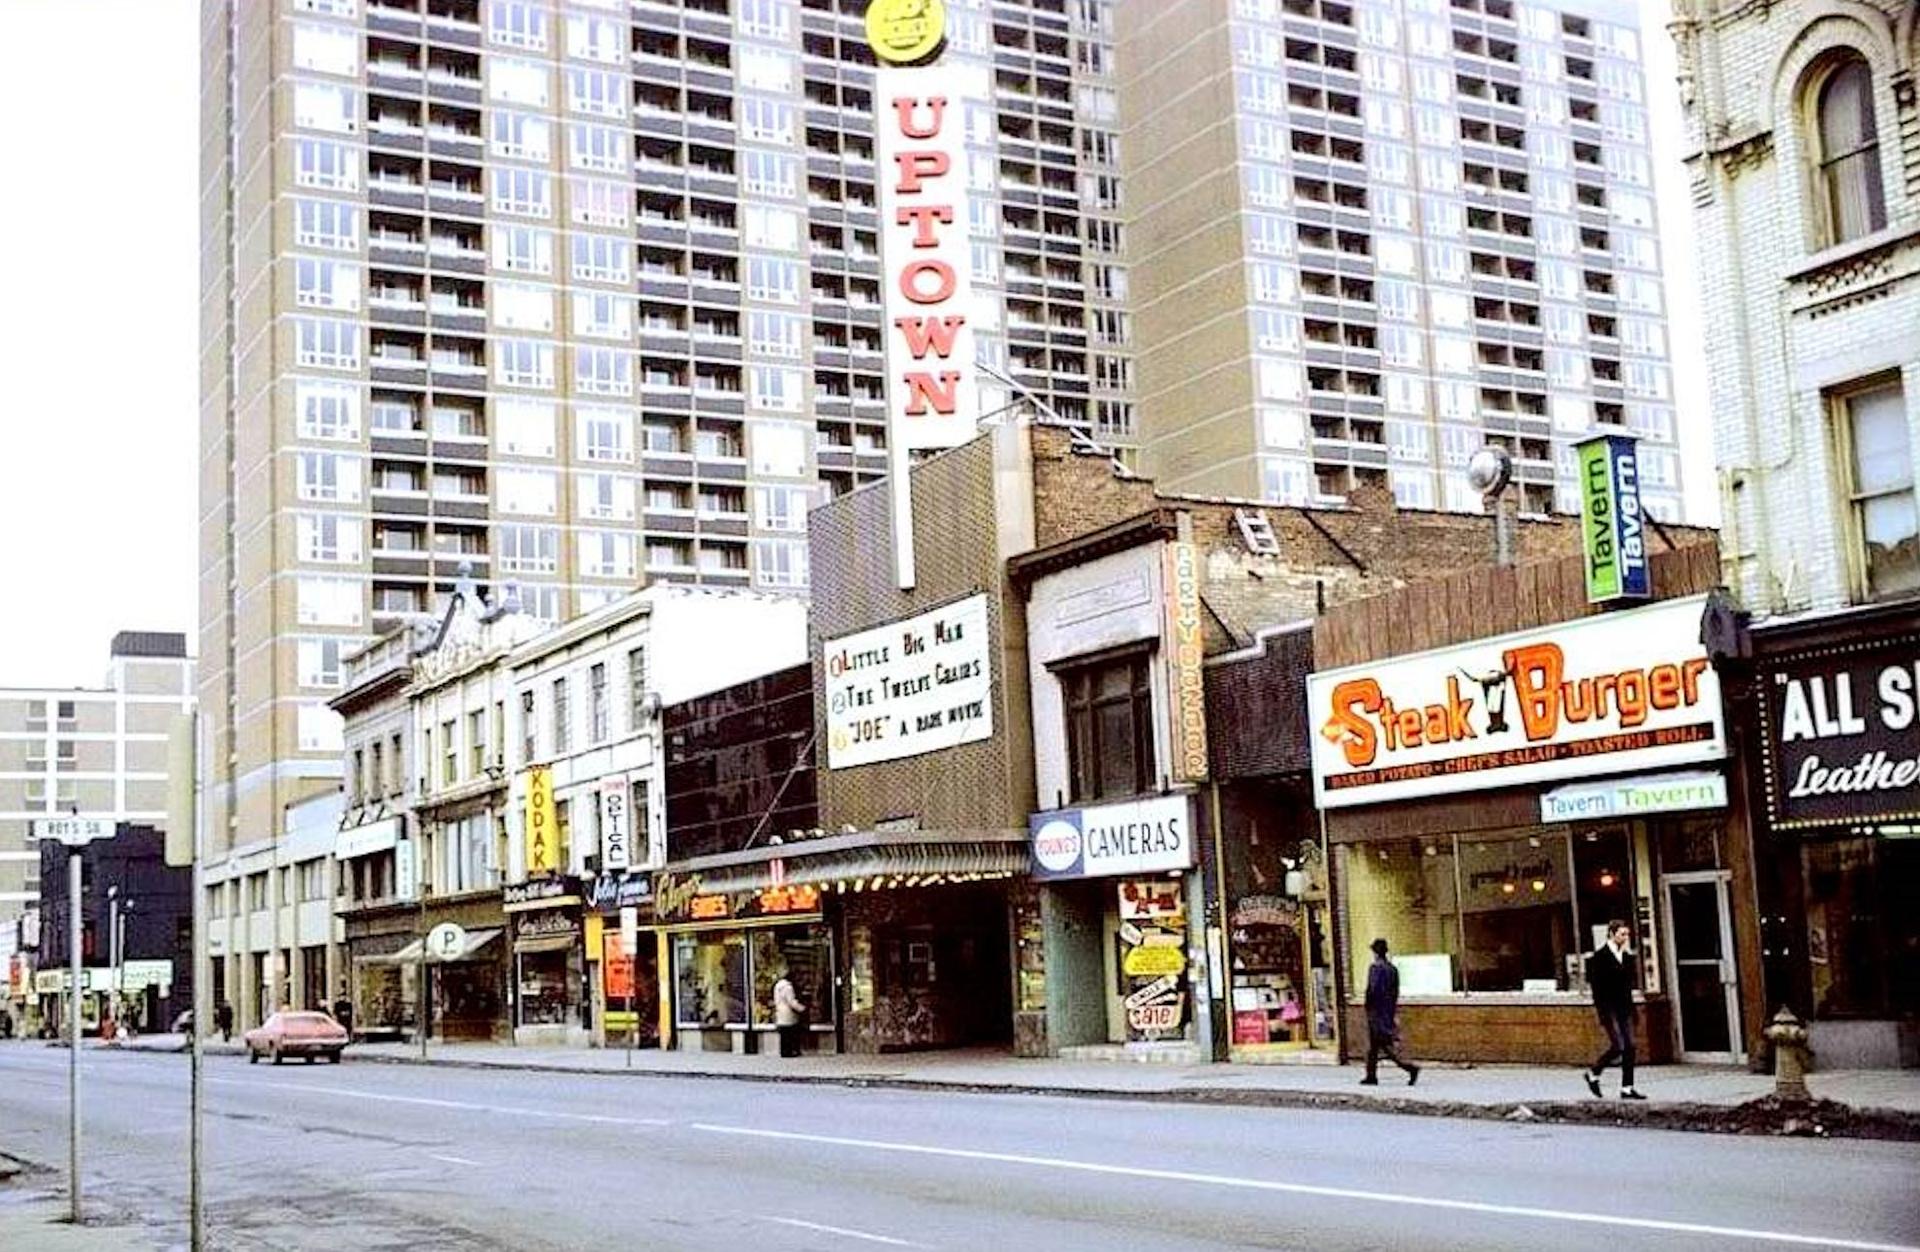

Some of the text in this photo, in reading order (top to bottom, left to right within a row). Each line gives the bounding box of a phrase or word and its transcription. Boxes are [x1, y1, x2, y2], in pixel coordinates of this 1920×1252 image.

[892, 96, 966, 416] UPTOWN
[1592, 458, 1611, 580] Tavern
[1618, 454, 1645, 576] Tavern
[849, 715, 890, 743] "JOE"
[900, 720, 908, 736] A
[1330, 641, 1711, 767] Steak Burger
[1877, 659, 1920, 730] S
[1380, 763, 1434, 783] POTATO
[1503, 745, 1557, 765] SALAD
[1571, 734, 1650, 756] TOASTED
[531, 767, 546, 868] KODAK
[607, 794, 624, 862] OPTICAL
[1547, 784, 1715, 814] Tavern Tavern
[1087, 817, 1181, 859] CAMERAS
[443, 930, 456, 948] P
